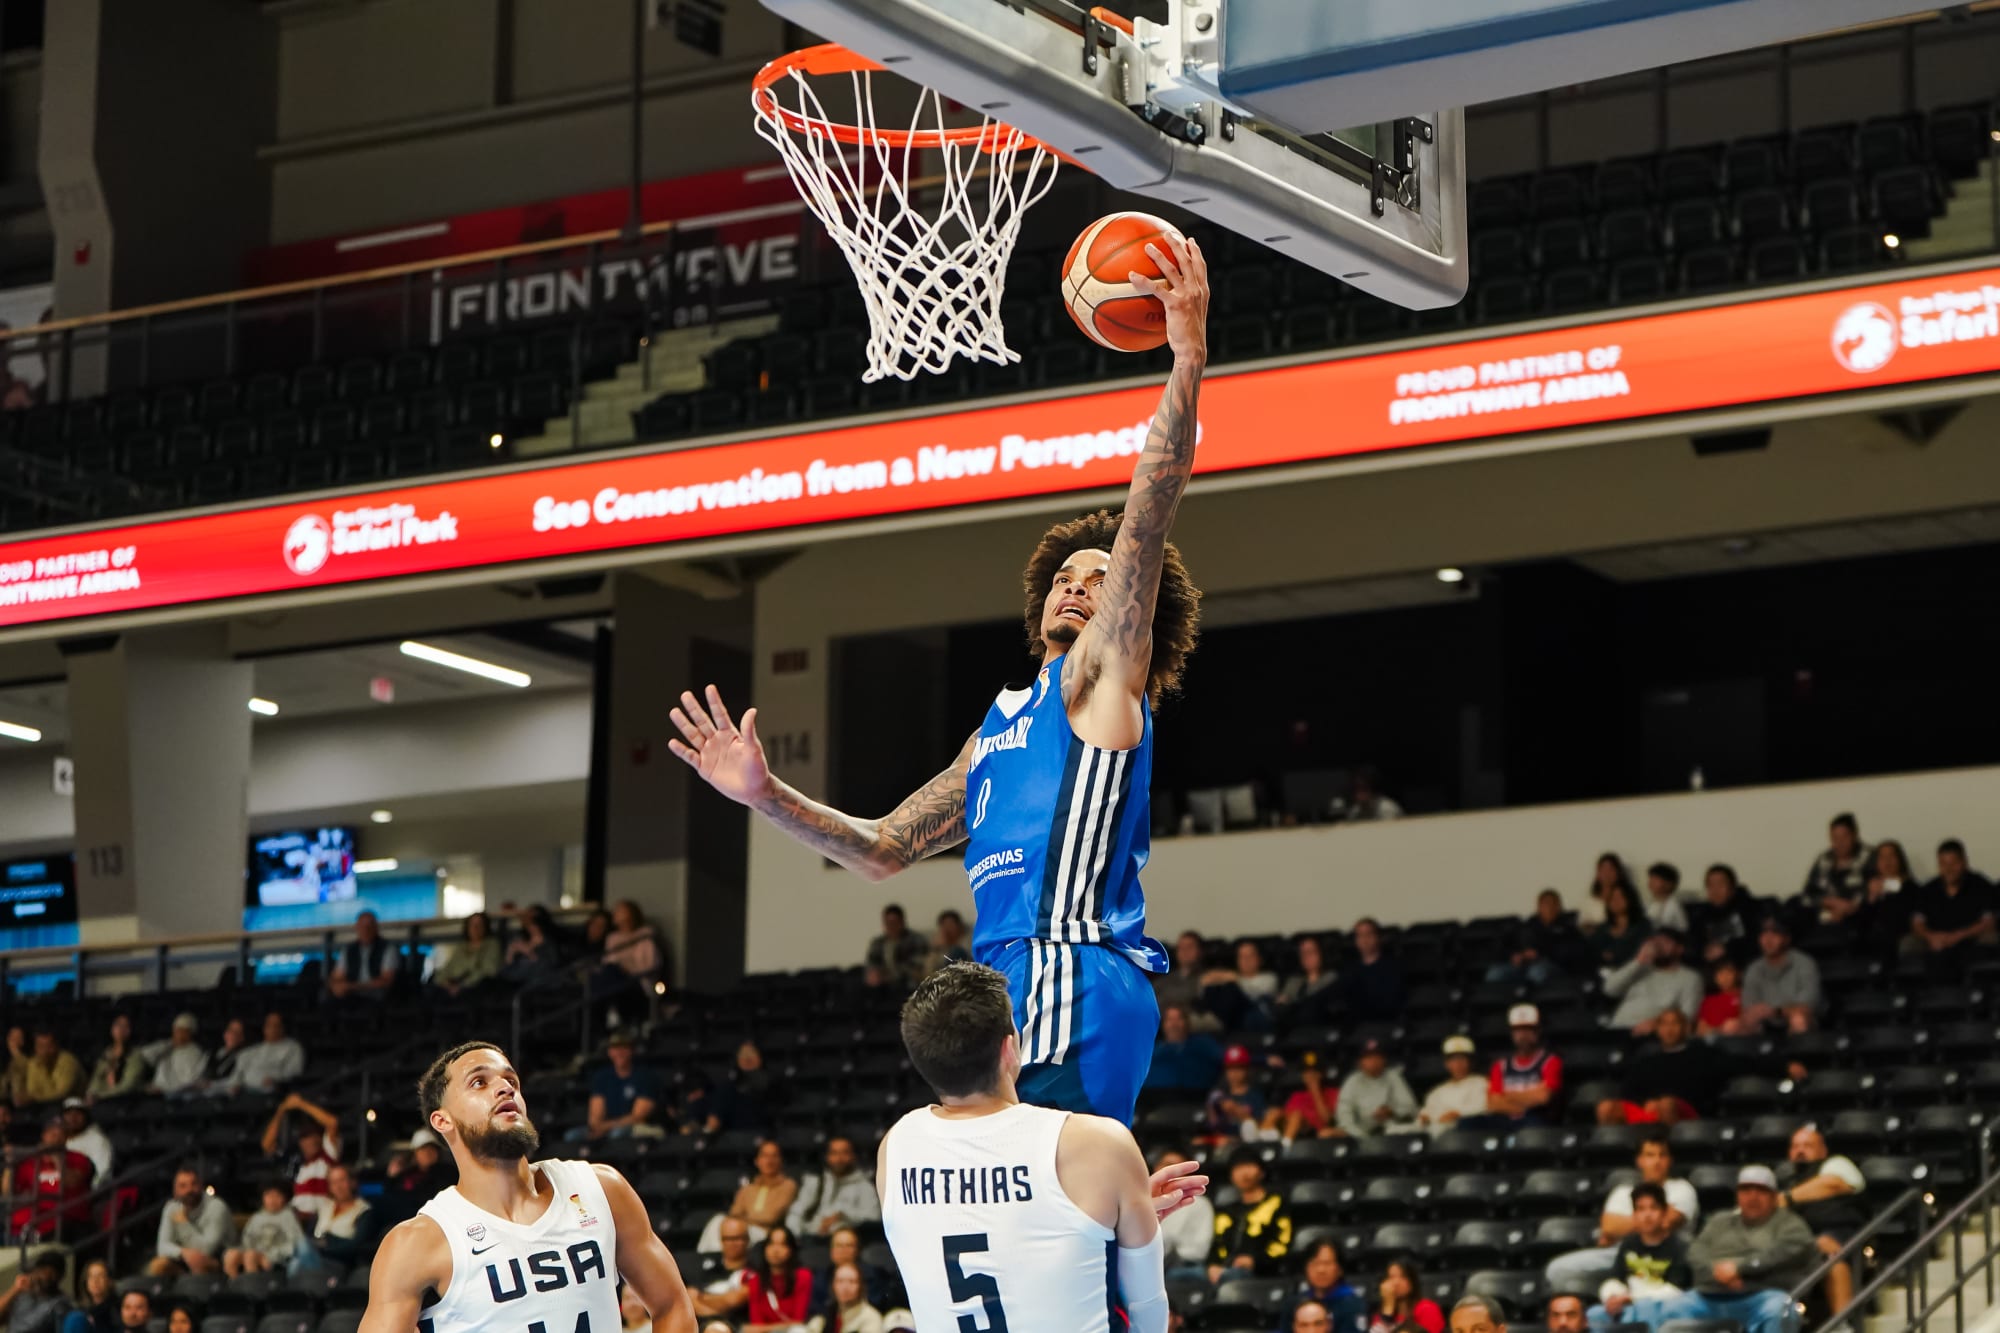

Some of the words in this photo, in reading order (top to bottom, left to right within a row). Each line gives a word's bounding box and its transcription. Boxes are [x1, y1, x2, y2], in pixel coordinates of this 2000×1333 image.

[1397, 366, 1476, 396] PROUD
[1479, 350, 1584, 385] PARTNER
[1587, 345, 1621, 370] OF
[1389, 381, 1542, 425] FRONTWAVE
[1543, 371, 1630, 404] ARENA
[533, 496, 590, 532] See
[593, 468, 803, 524] Conservation
[805, 459, 887, 497] from
[890, 457, 915, 485] a
[918, 445, 997, 482] New
[402, 511, 458, 546] Park
[35, 550, 109, 578] PARTNER
[111, 546, 136, 567] OF
[79, 568, 141, 596] ARENA
[973, 778, 991, 830] 0
[901, 1166, 1033, 1205] MATHIAS
[486, 1240, 606, 1304] USA
[942, 1233, 1010, 1333] 5
